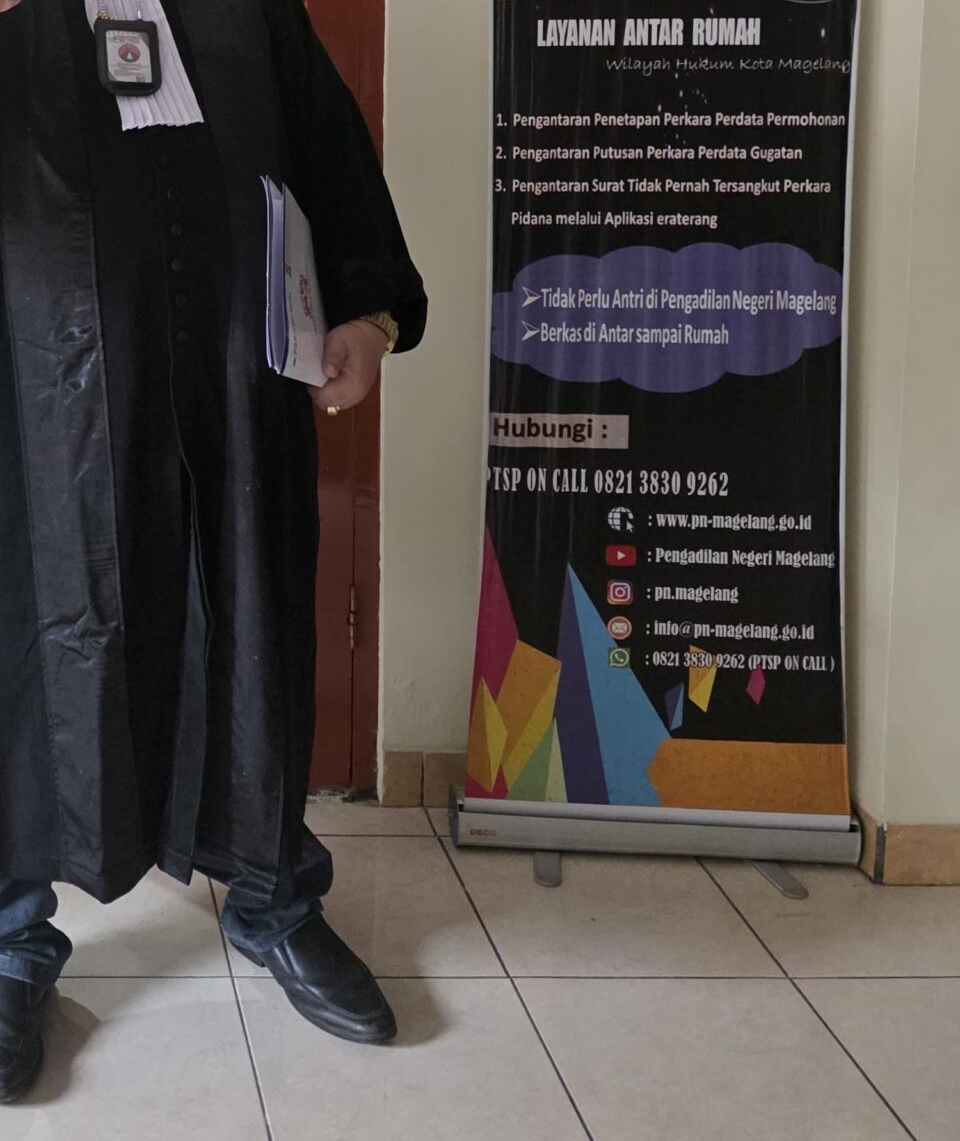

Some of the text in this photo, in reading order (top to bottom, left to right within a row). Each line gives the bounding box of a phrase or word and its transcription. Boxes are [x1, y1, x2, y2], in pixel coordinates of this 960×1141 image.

[537, 18, 761, 47] LAYANAN ANTAR RUMAH
[607, 58, 852, 76] Wilayah Hukum Kota Magelang
[496, 112, 845, 130] 1. Pengantaran Penetapan Perkara Perdata Permohonan
[496, 145, 802, 162] 2. Pengantaran Putusan Perkara Perdata Gugatan
[494, 178, 831, 196] 3. Pengantaran Surat Tidak Pernah Tersangkut Perkara
[512, 212, 718, 229] Pidana melalui Aplikasi eraterang
[541, 288, 836, 315] Tidak Perlu Antri di Pengadilan Negeri Magelang
[540, 322, 728, 348] Berkas di Antar sampai Rumah
[493, 417, 593, 443] Hubungi
[526, 467, 547, 492] ON
[552, 468, 588, 493] CALL
[594, 469, 632, 494] 0821
[640, 470, 681, 495] 3830
[687, 472, 728, 496] 9262
[656, 513, 812, 530] www.pn-magelang.go.id
[656, 548, 728, 566] Pengadilan
[732, 550, 772, 568] Negeri
[776, 550, 836, 568] Magelang
[654, 586, 738, 604] pn.magelang
[654, 620, 815, 641] info@pn-magelang.go.id
[652, 652, 680, 666] 0821
[684, 652, 712, 668] 3830
[716, 654, 745, 669] 9262
[748, 654, 781, 670] (PTSP
[784, 655, 800, 670] ON
[802, 656, 828, 670] CALL
